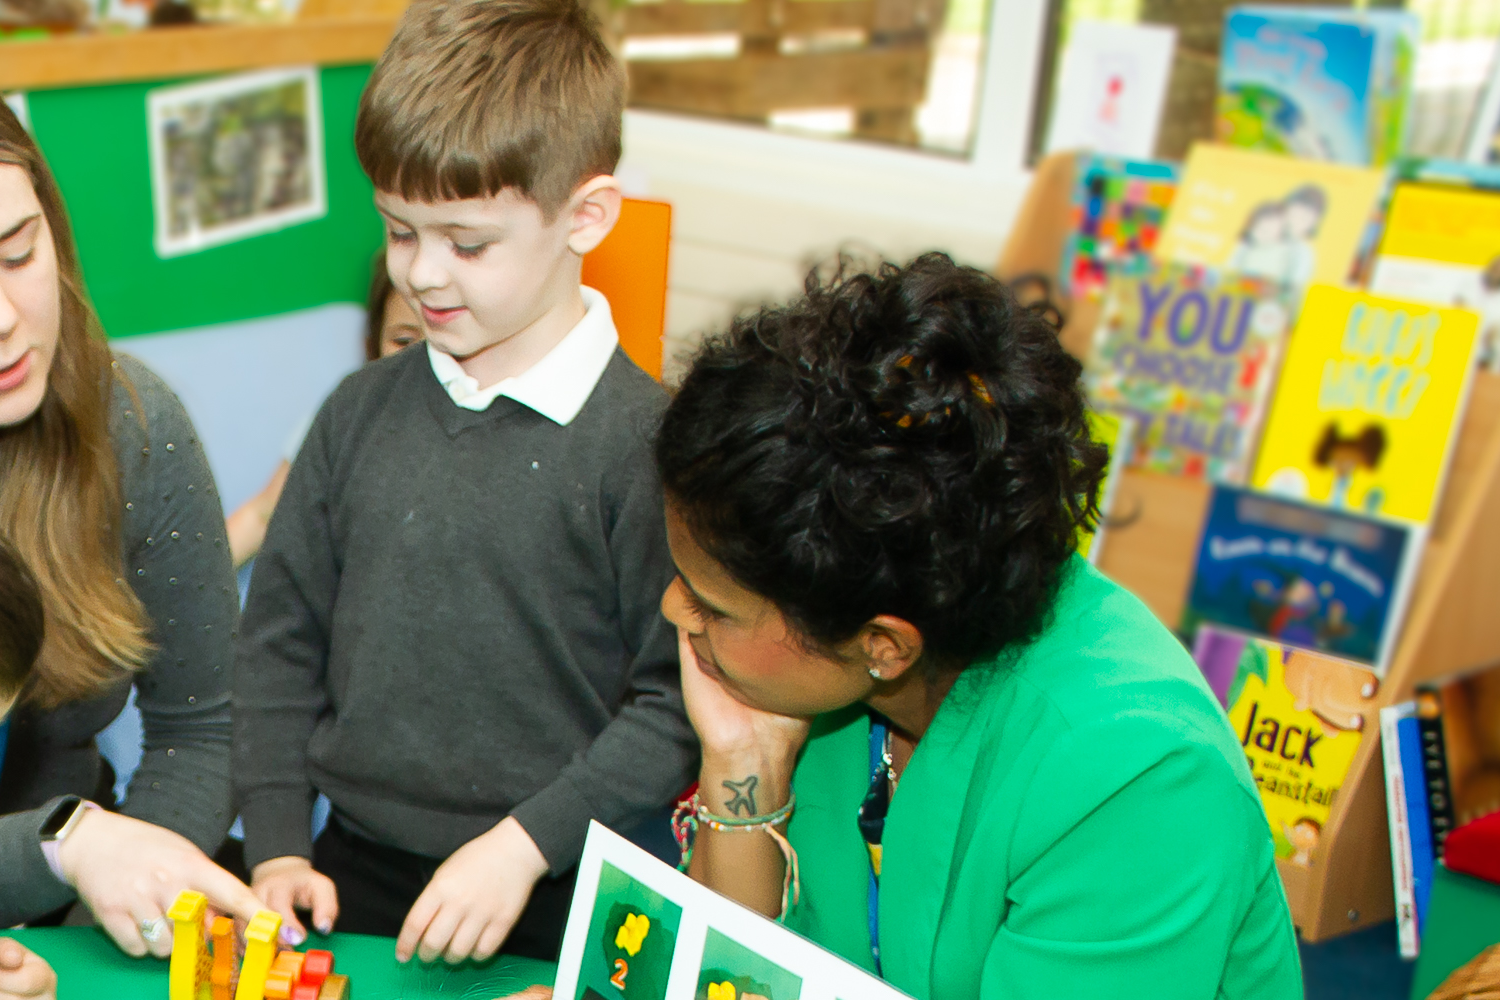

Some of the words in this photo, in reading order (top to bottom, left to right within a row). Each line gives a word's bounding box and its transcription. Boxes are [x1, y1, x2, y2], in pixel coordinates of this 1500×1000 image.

[1137, 281, 1255, 356] YOU
[1242, 700, 1323, 769] Jack
[610, 958, 628, 991] 2
